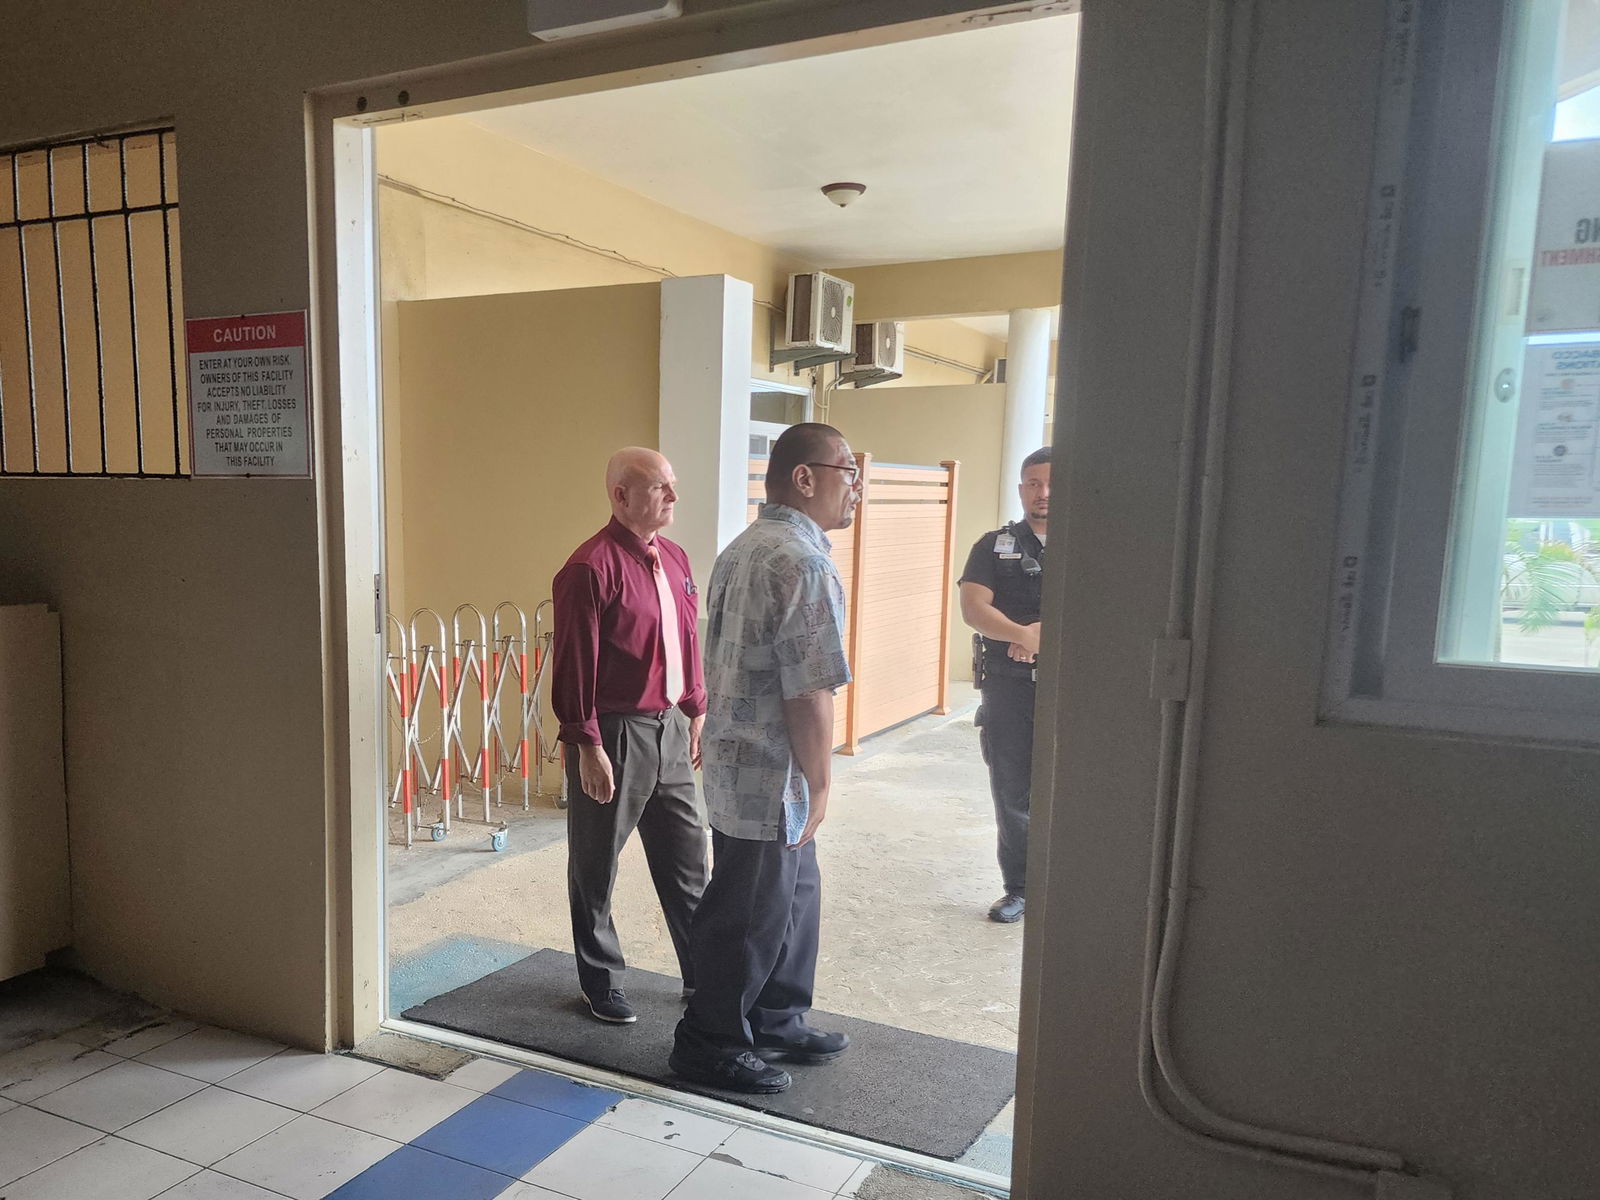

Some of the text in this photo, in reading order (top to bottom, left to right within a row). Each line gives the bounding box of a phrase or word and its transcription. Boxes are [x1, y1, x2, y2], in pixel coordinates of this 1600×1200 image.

[213, 325, 277, 343] CAUTION
[199, 359, 222, 370] ENTER
[223, 358, 232, 369] AT
[233, 357, 253, 368] YOUR
[254, 356, 271, 367] OWN
[200, 369, 294, 384] OWNERS OF THIS FACILITY
[207, 384, 287, 398] ACCEPTS NO LIABILITY
[197, 402, 212, 412] FOR
[268, 398, 297, 410] LOSSES
[216, 412, 281, 425] AND DAMAGES OF
[206, 426, 293, 439] PERSONAL PROPERTIES
[215, 441, 283, 453] THAT MAY OCCUR IN
[226, 455, 275, 467] THIS FACILITY
